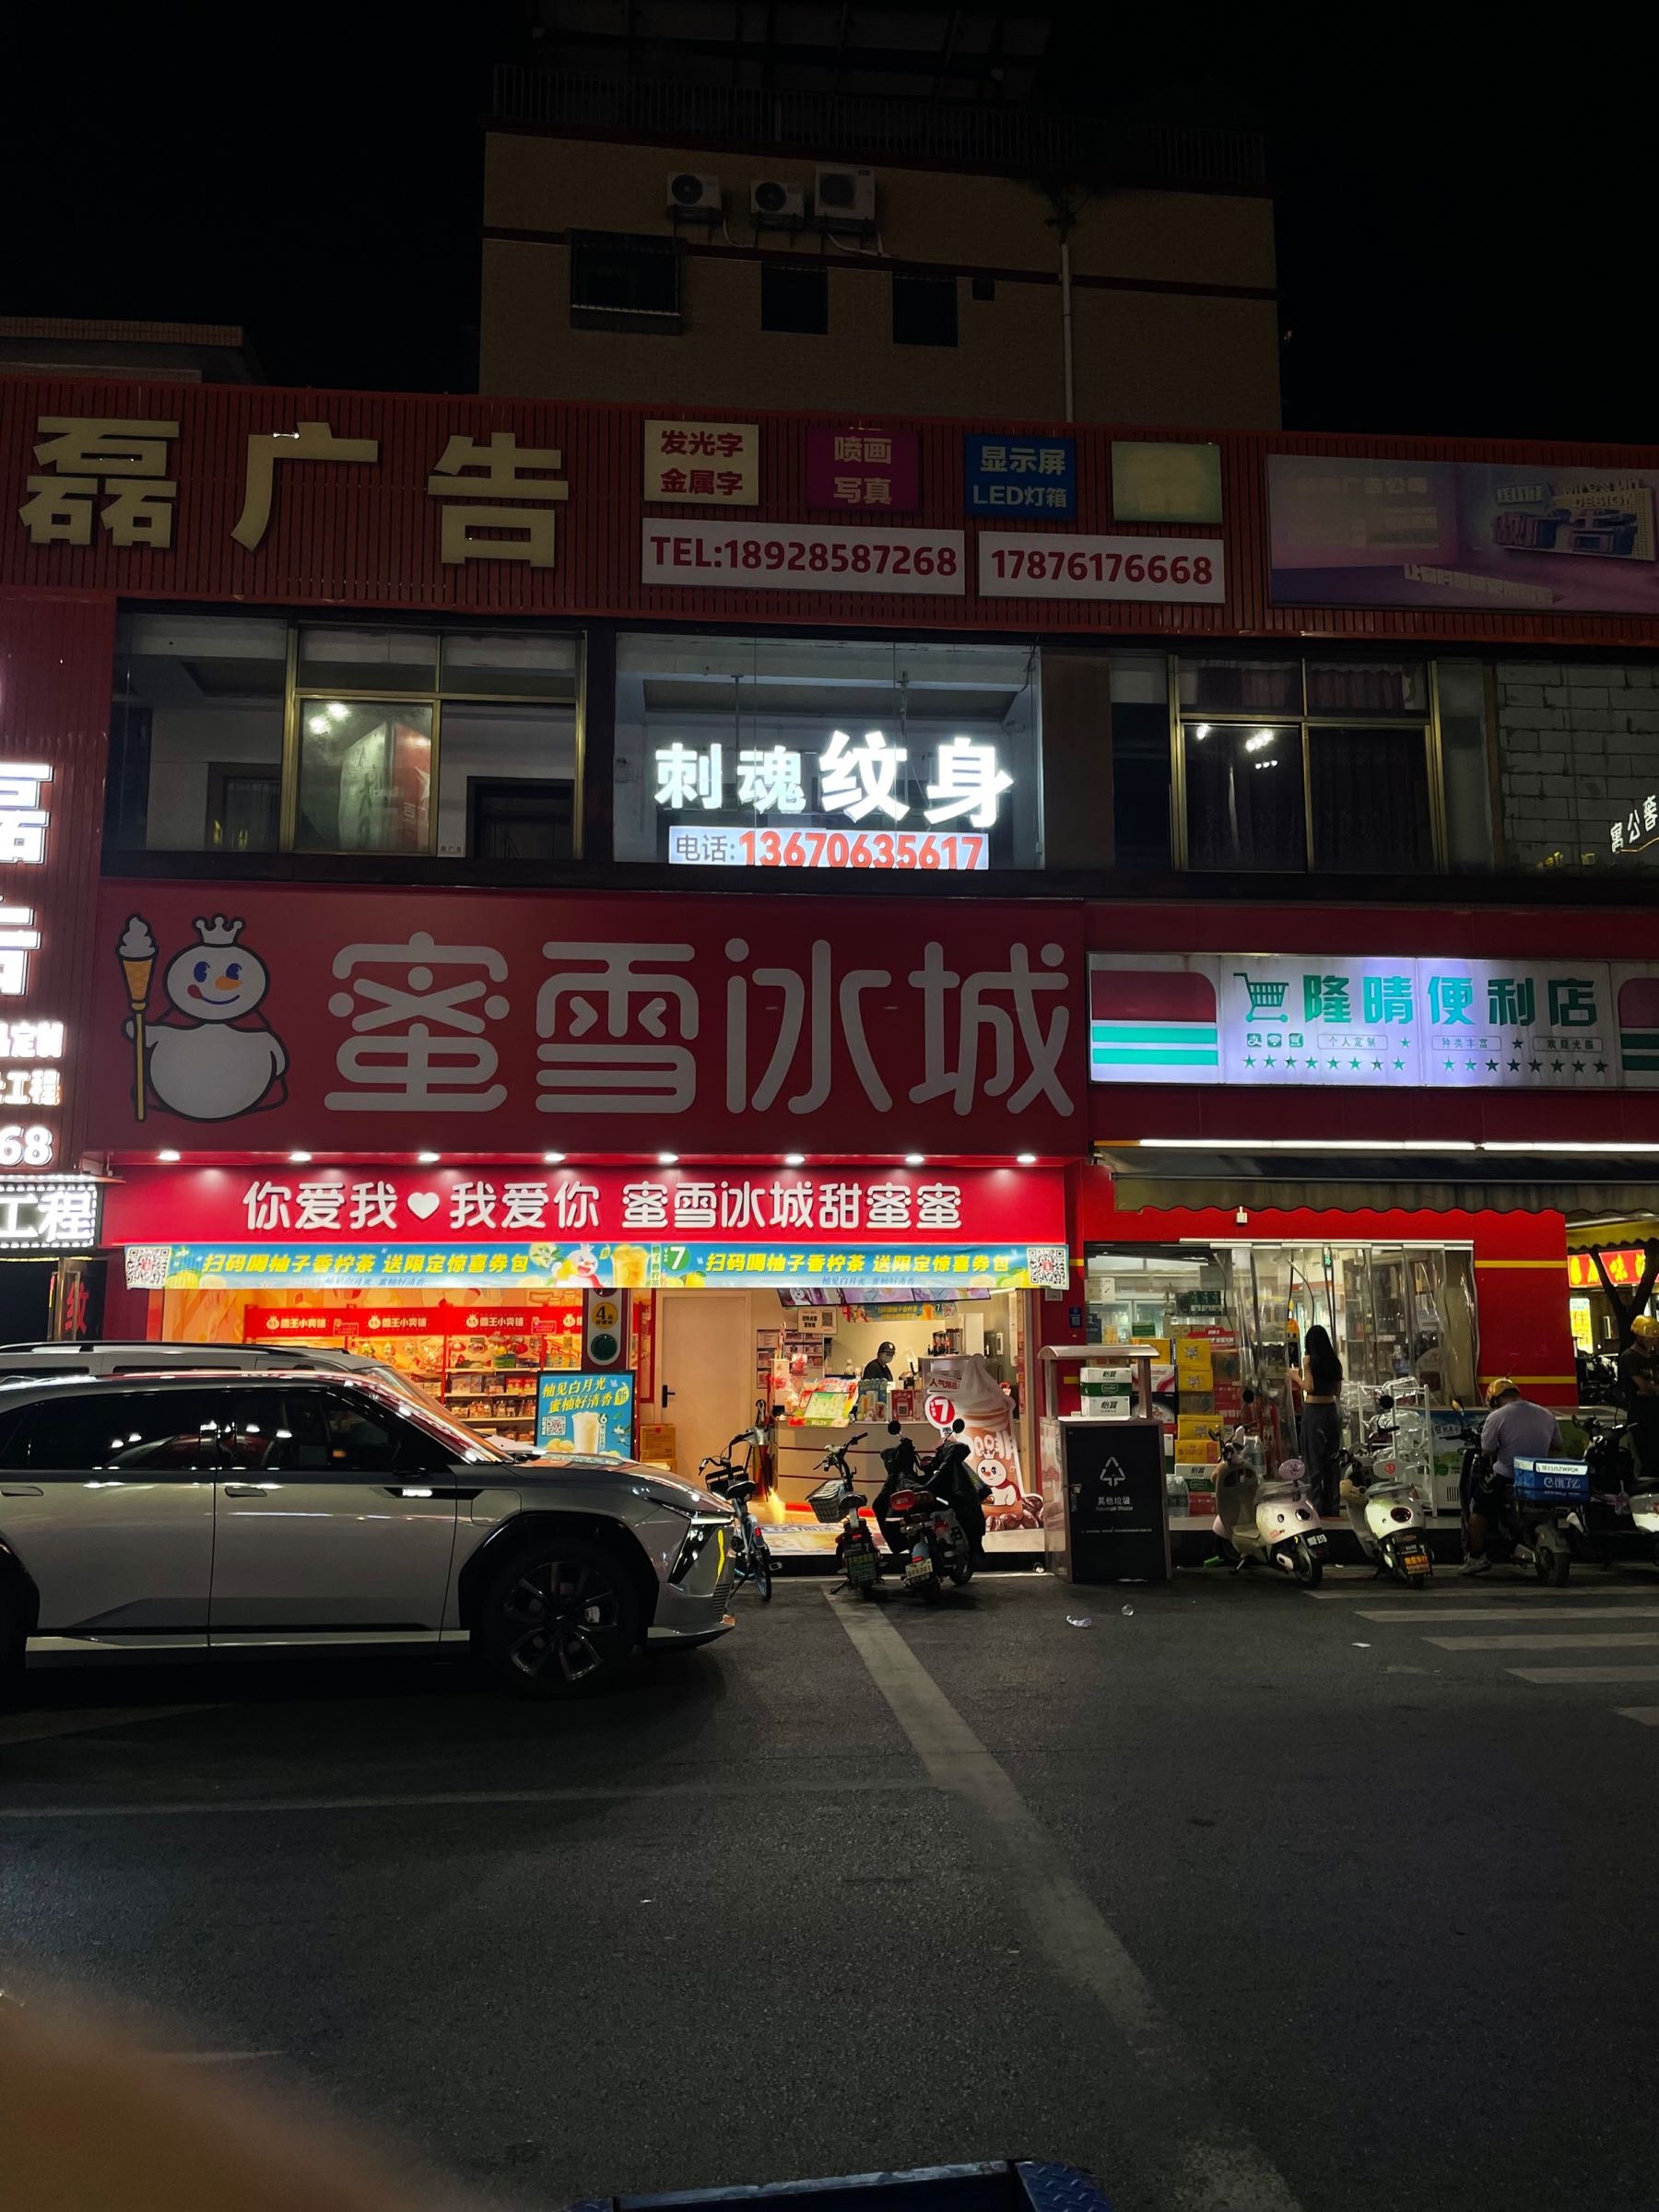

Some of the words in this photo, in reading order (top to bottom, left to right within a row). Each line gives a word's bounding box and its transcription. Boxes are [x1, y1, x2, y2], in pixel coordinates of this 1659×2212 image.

[660, 429, 744, 458] 发光字
[833, 436, 892, 465] 喷画
[980, 445, 1066, 477] 显示屏
[18, 416, 569, 568] 磊广告
[660, 467, 744, 496] 金属字
[833, 477, 892, 505] 写真
[973, 485, 1067, 510] LED灯箱
[651, 535, 958, 577] TEL:18928587268
[990, 548, 1213, 585] 17876176668
[654, 730, 1014, 828] 刺魂纹身
[1303, 974, 1596, 1027] 隆晴便利店
[324, 931, 1075, 1116] 蜜雪冰城
[1328, 1036, 1376, 1047] 个人定制
[1442, 1038, 1488, 1049] 种类丰富
[0, 1071, 60, 1105] 工程
[243, 1180, 396, 1230] 你爱我
[449, 1180, 600, 1230] 我爱你
[622, 1180, 961, 1230] 蜜雪冰城甜蜜蜜
[203, 1253, 375, 1274] 扫码喝柚子香柠茶
[383, 1253, 529, 1274] 送限定惊喜券包
[706, 1253, 865, 1273] 扫码喝柚子香柠茶
[873, 1253, 1010, 1273] 送限定惊喜券包
[542, 1377, 606, 1398] 柚见白月光
[548, 1392, 614, 1414] 蜜柚好清香
[1097, 1496, 1131, 1506] 其他垃圾
